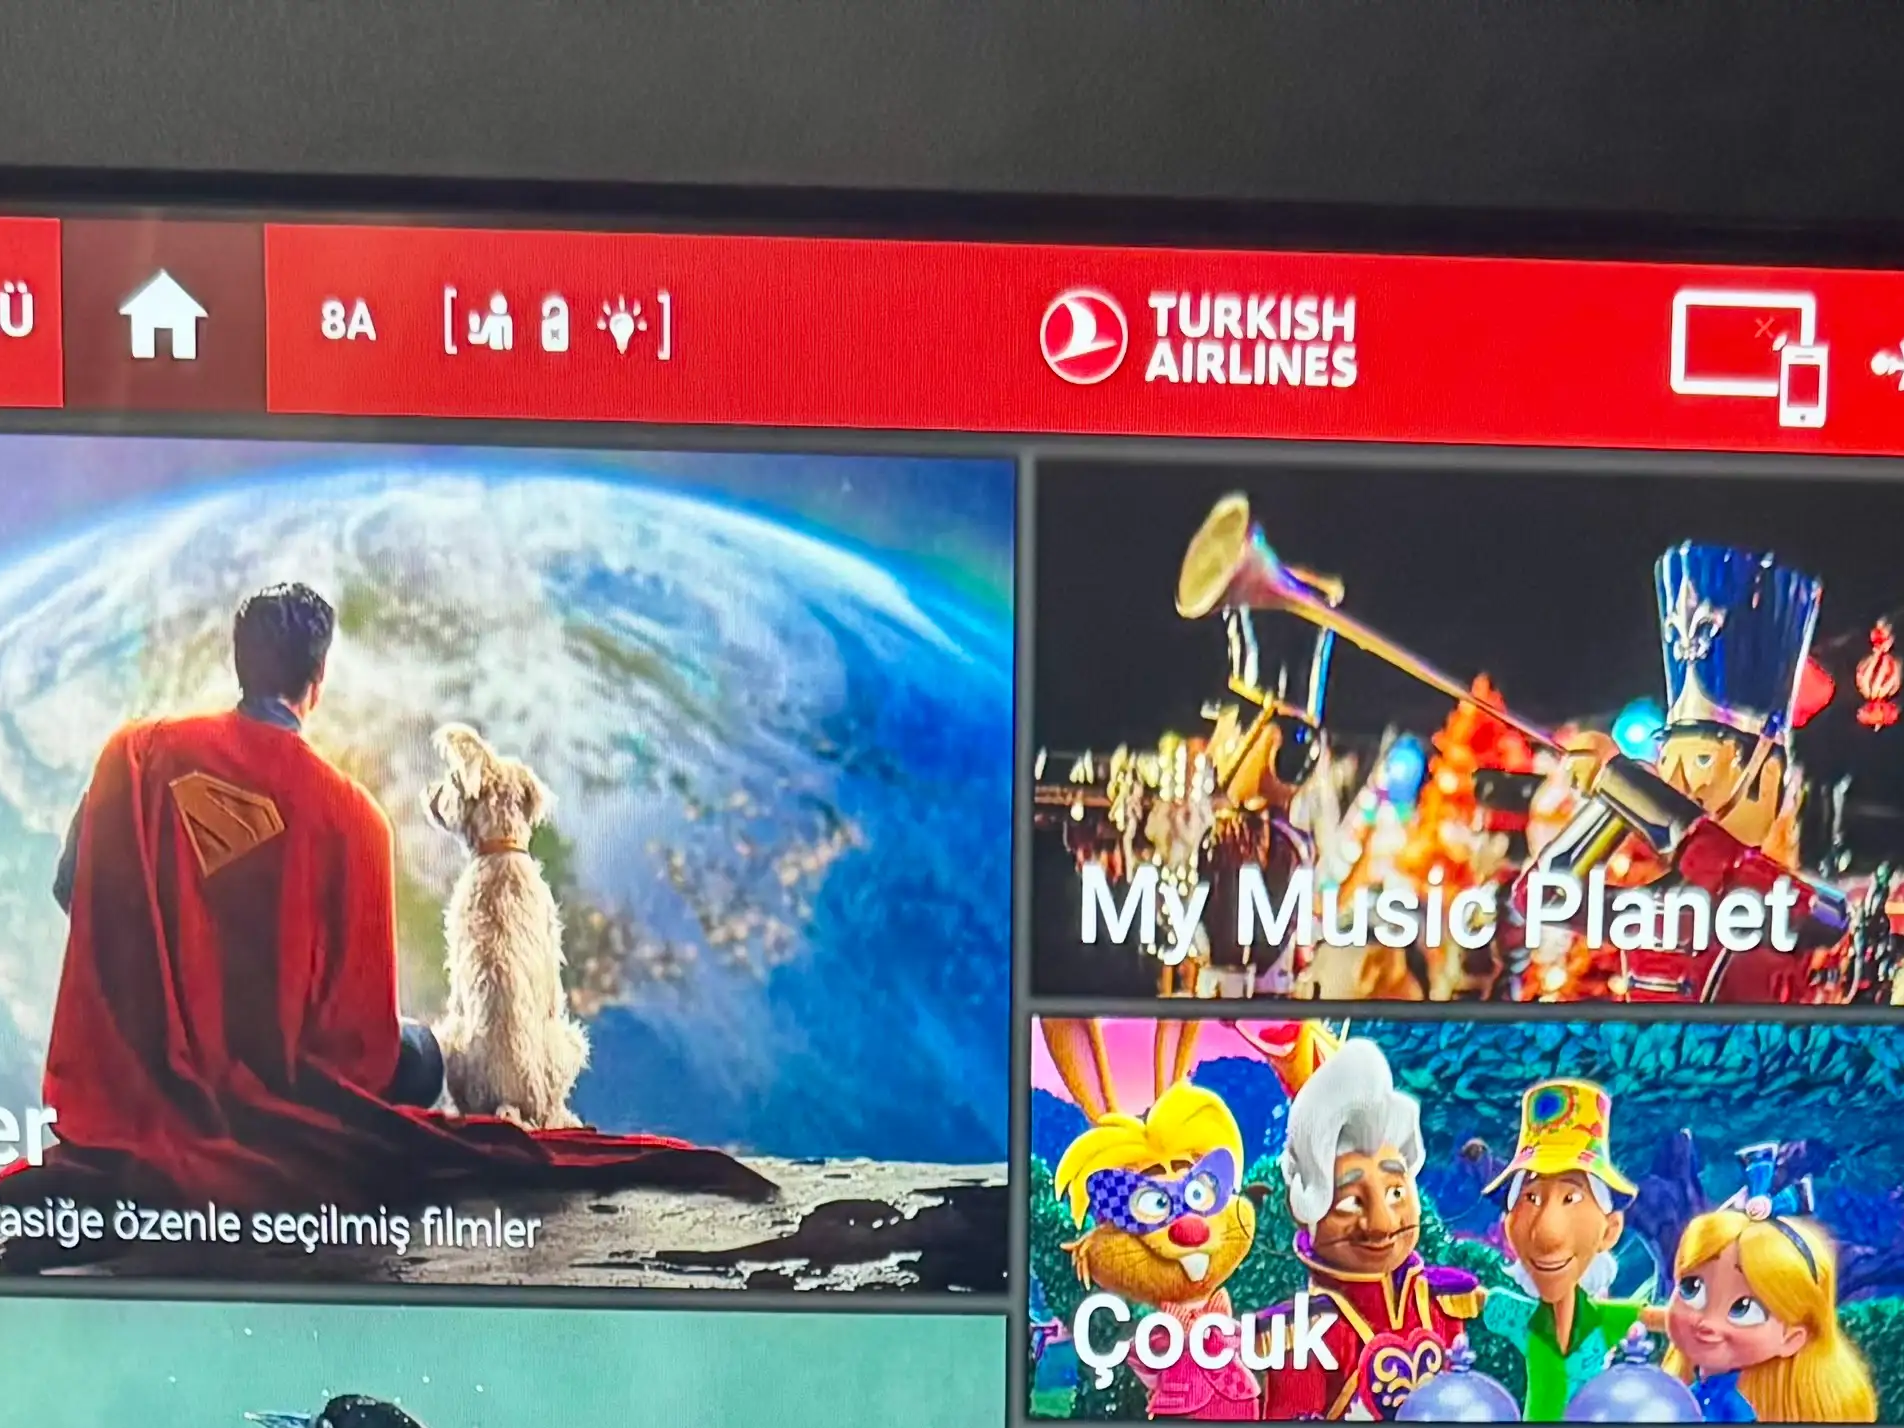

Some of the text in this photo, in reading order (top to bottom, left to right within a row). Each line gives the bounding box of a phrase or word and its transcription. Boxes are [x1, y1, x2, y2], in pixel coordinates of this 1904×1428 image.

[320, 297, 377, 342] 8A
[1147, 291, 1357, 342] TURKISH
[1144, 340, 1358, 388] AIRLINES
[1078, 862, 1798, 966] My Music Planet
[115, 1199, 240, 1243] özenle
[252, 1204, 412, 1257] seçilmiş
[420, 1206, 542, 1250] filmler
[1072, 1293, 1340, 1391] Çocuk
